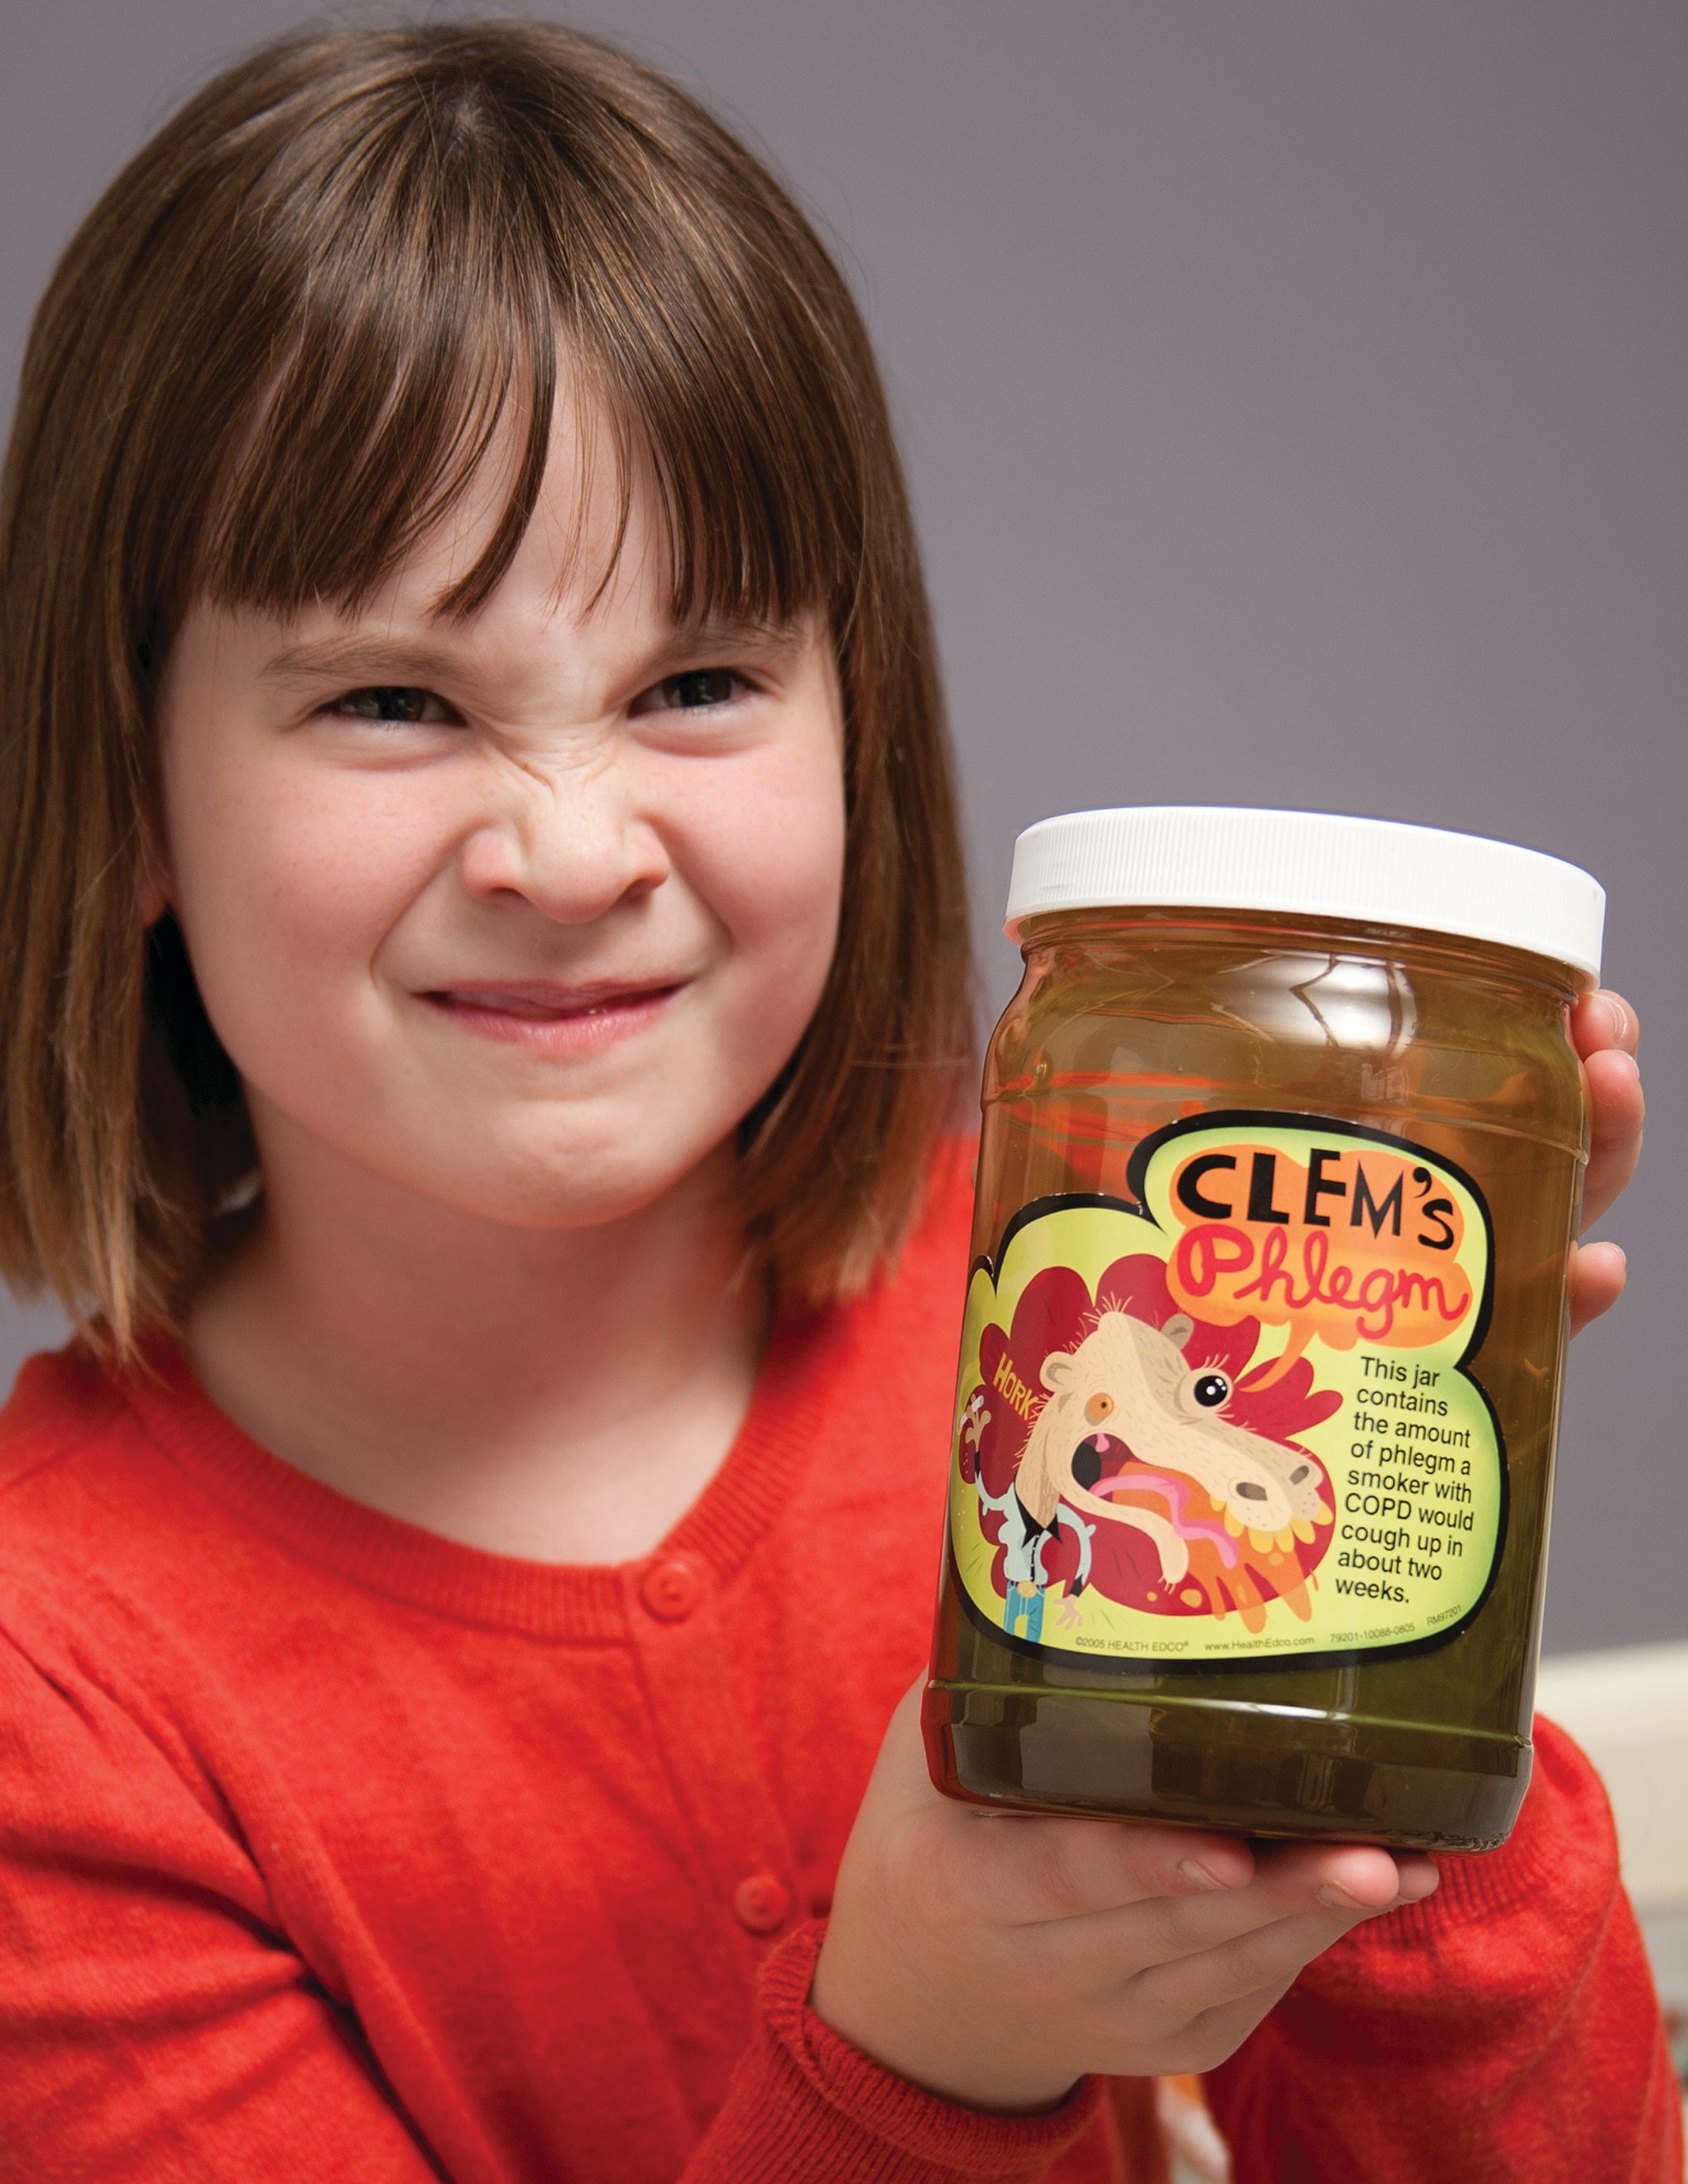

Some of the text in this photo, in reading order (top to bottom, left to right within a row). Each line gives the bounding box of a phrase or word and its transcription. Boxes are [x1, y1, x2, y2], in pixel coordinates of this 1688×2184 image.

[1177, 1224, 1469, 1339] Phlegm
[993, 1352, 1038, 1420] HORK
[1360, 1355, 1440, 1389] This jar
[1357, 1388, 1448, 1416] contains
[1354, 1412, 1470, 1448] the amount
[1350, 1440, 1470, 1476] of phlegm a
[1347, 1469, 1472, 1503] smoker with
[1345, 1492, 1474, 1531] COPD would
[1341, 1524, 1463, 1558] cough up in
[1338, 1549, 1442, 1580] about two
[1336, 1578, 1410, 1603] weeks.
[1108, 1640, 1149, 1651] HEALTH
